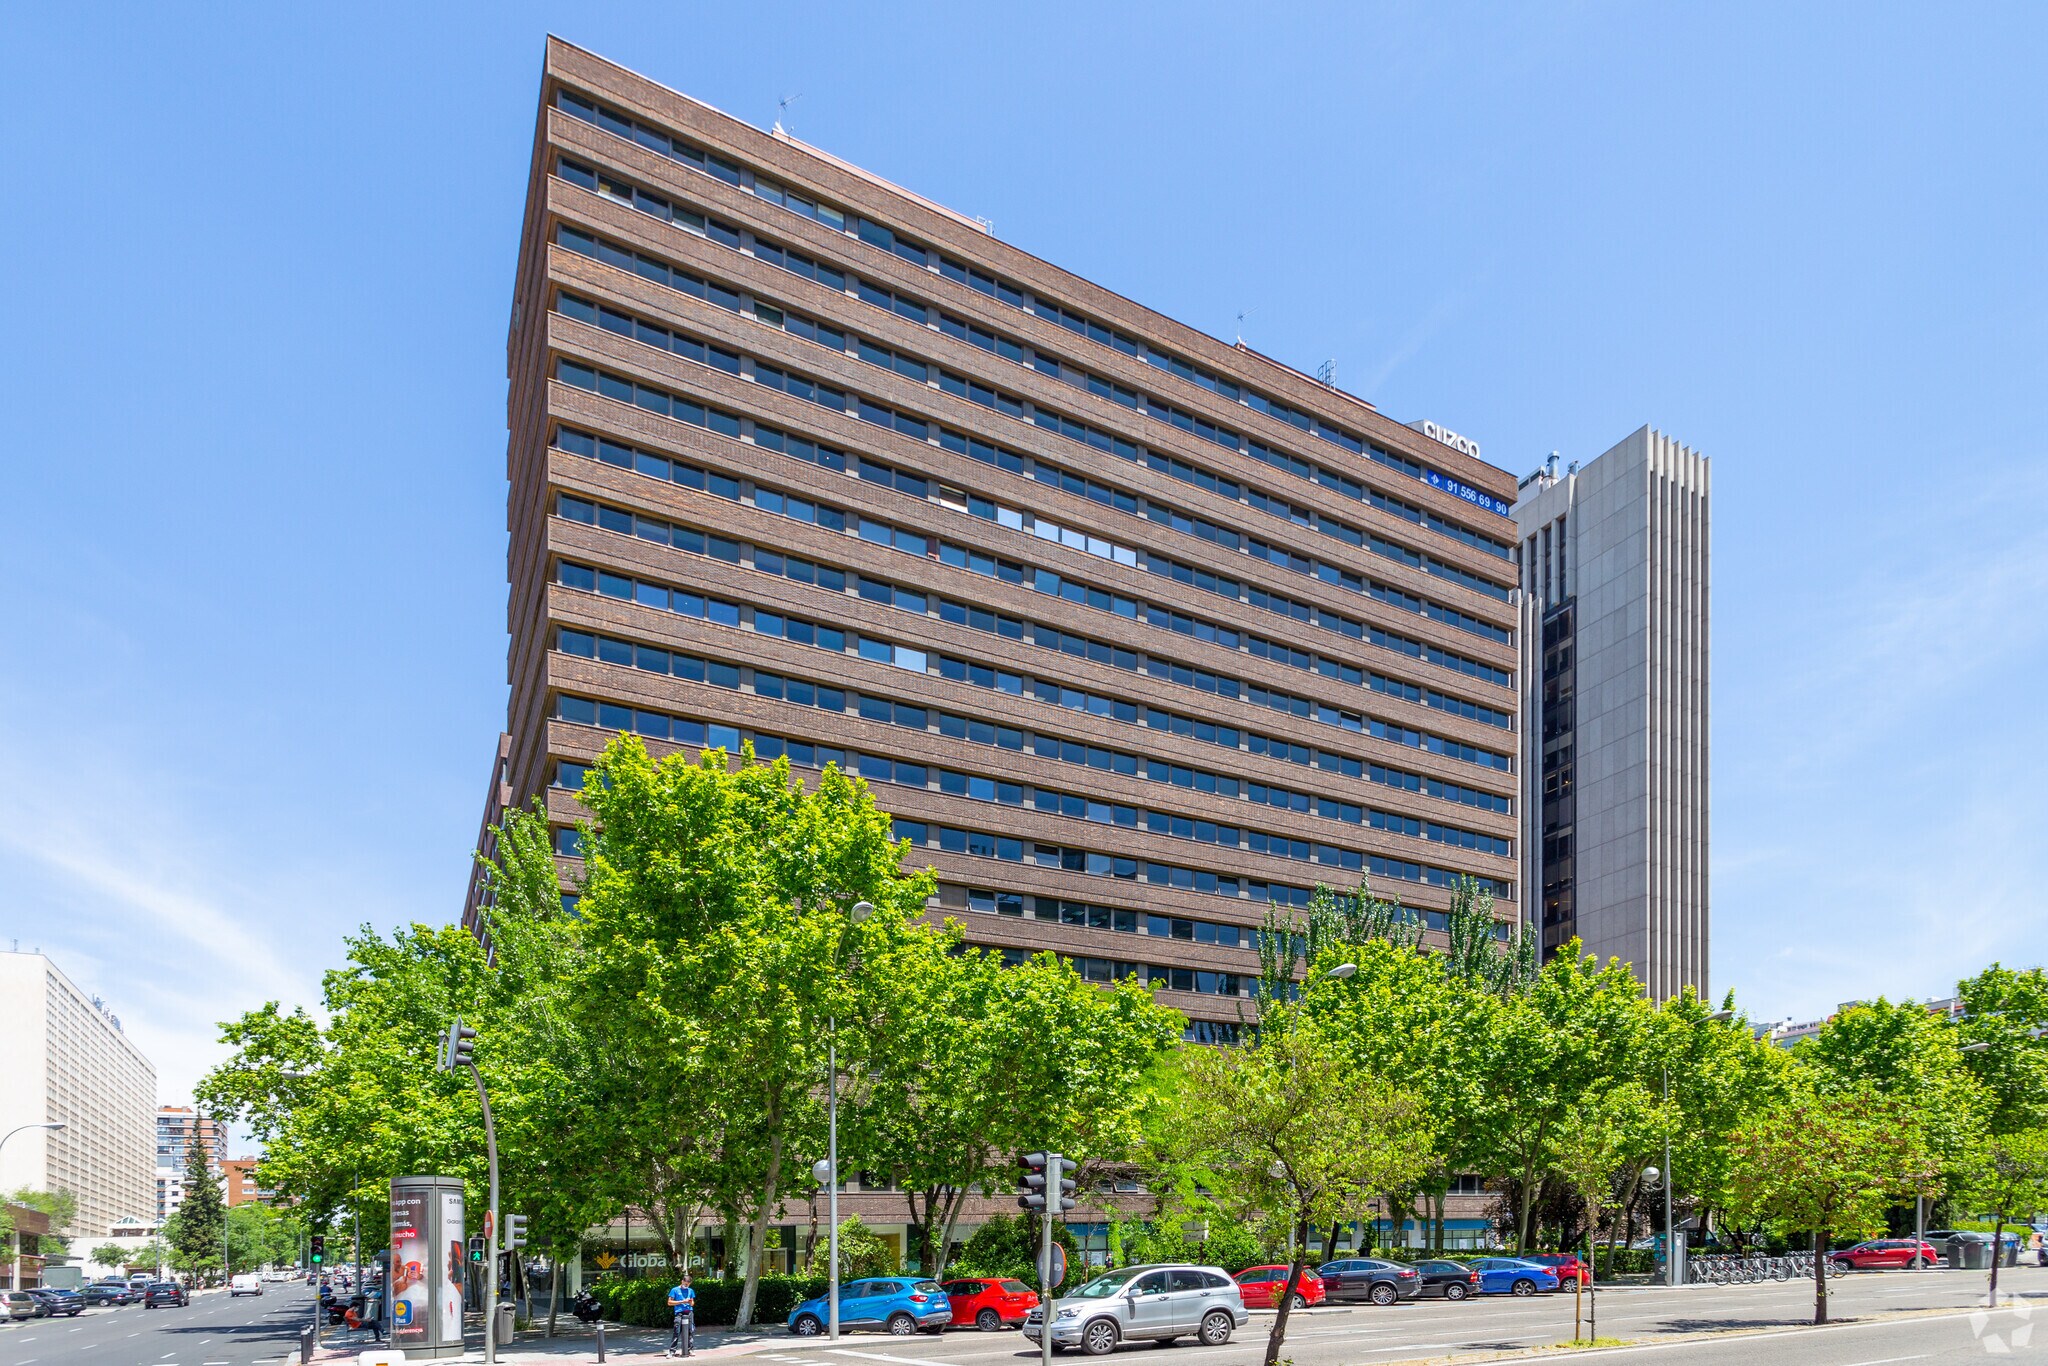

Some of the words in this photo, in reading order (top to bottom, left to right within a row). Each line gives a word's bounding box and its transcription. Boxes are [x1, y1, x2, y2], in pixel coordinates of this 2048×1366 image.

[1447, 480, 1458, 494] 91
[1460, 485, 1476, 502] 556
[1478, 494, 1491, 508] 69
[1495, 502, 1507, 514] 90
